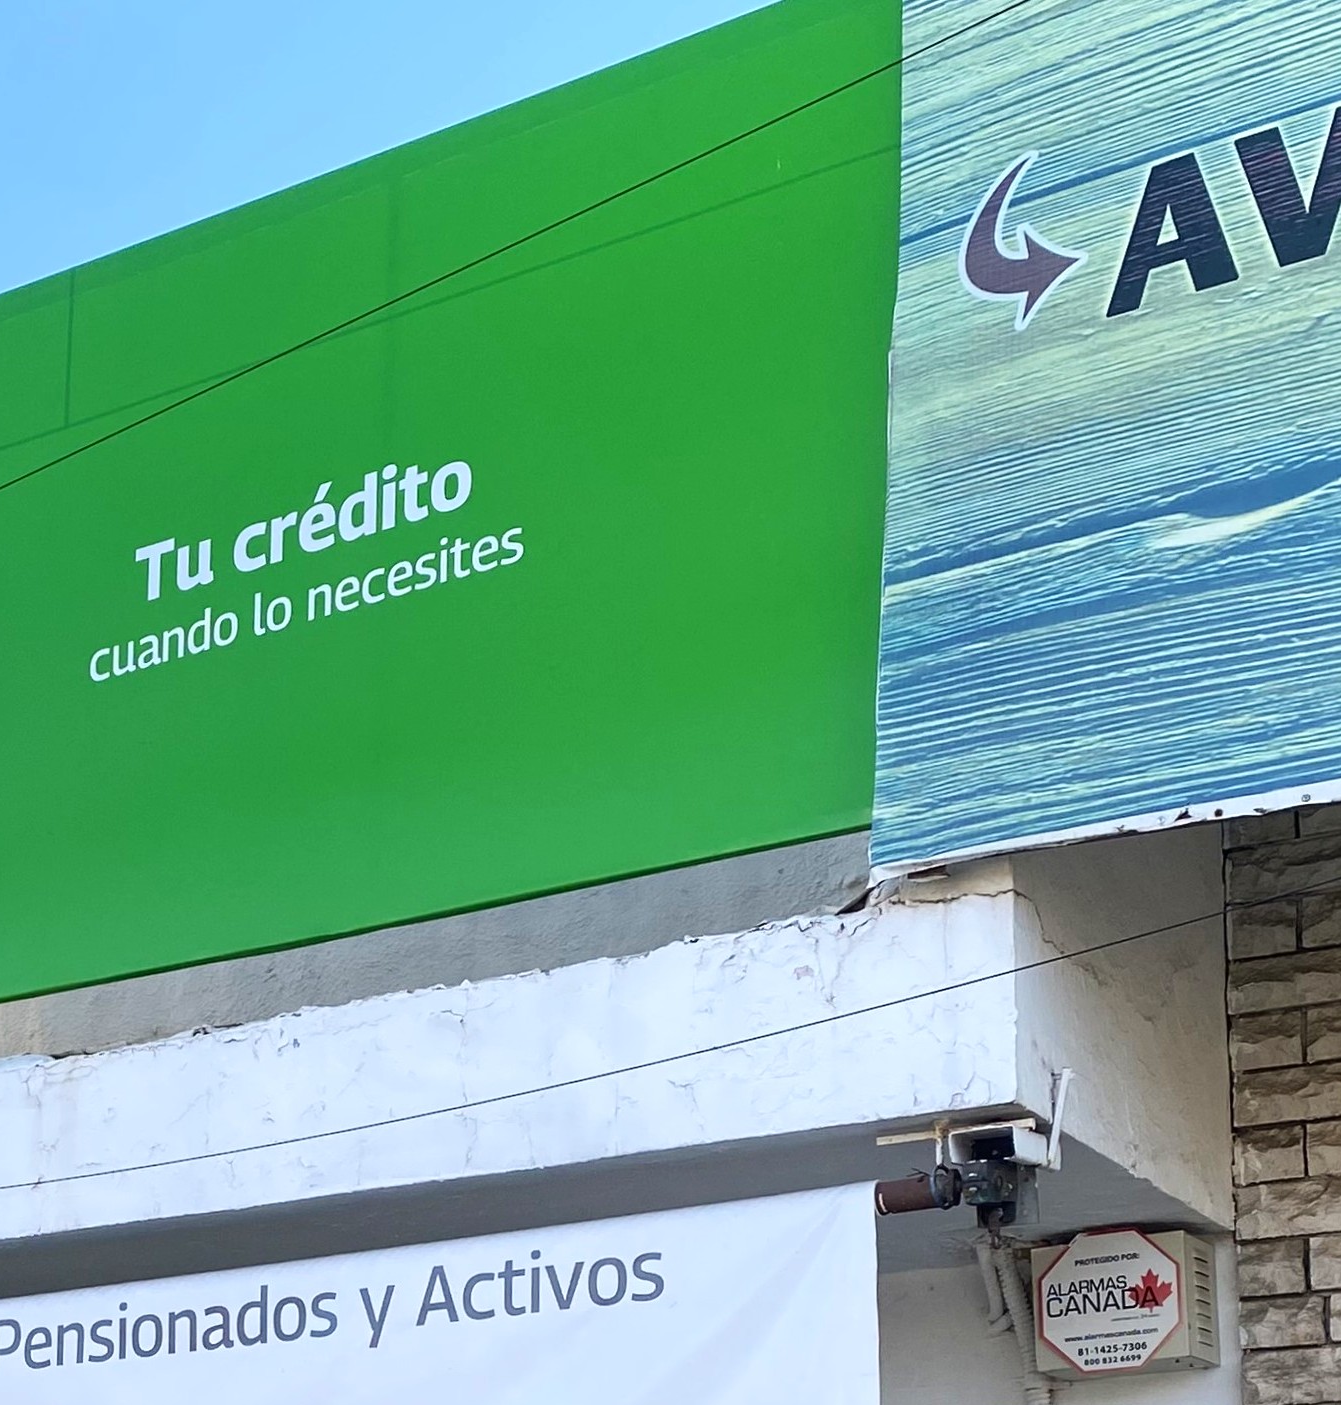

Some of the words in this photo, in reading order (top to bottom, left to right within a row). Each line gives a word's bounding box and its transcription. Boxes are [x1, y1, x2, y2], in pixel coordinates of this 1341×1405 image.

[135, 538, 214, 601] Tu
[233, 460, 472, 572] crédito
[90, 607, 238, 682] cuando
[254, 592, 292, 636] lo
[307, 527, 524, 621] necesites
[1074, 1253, 1120, 1267] PROTEGIDO
[360, 1284, 394, 1349] y
[416, 1248, 665, 1328] Activos
[1047, 1275, 1127, 1298] ALARMAS
[1046, 1286, 1159, 1318] CANADA
[1078, 1342, 1148, 1357] 81-1425-7306
[1084, 1357, 1100, 1366] 800
[1120, 1353, 1142, 1363] 6699
